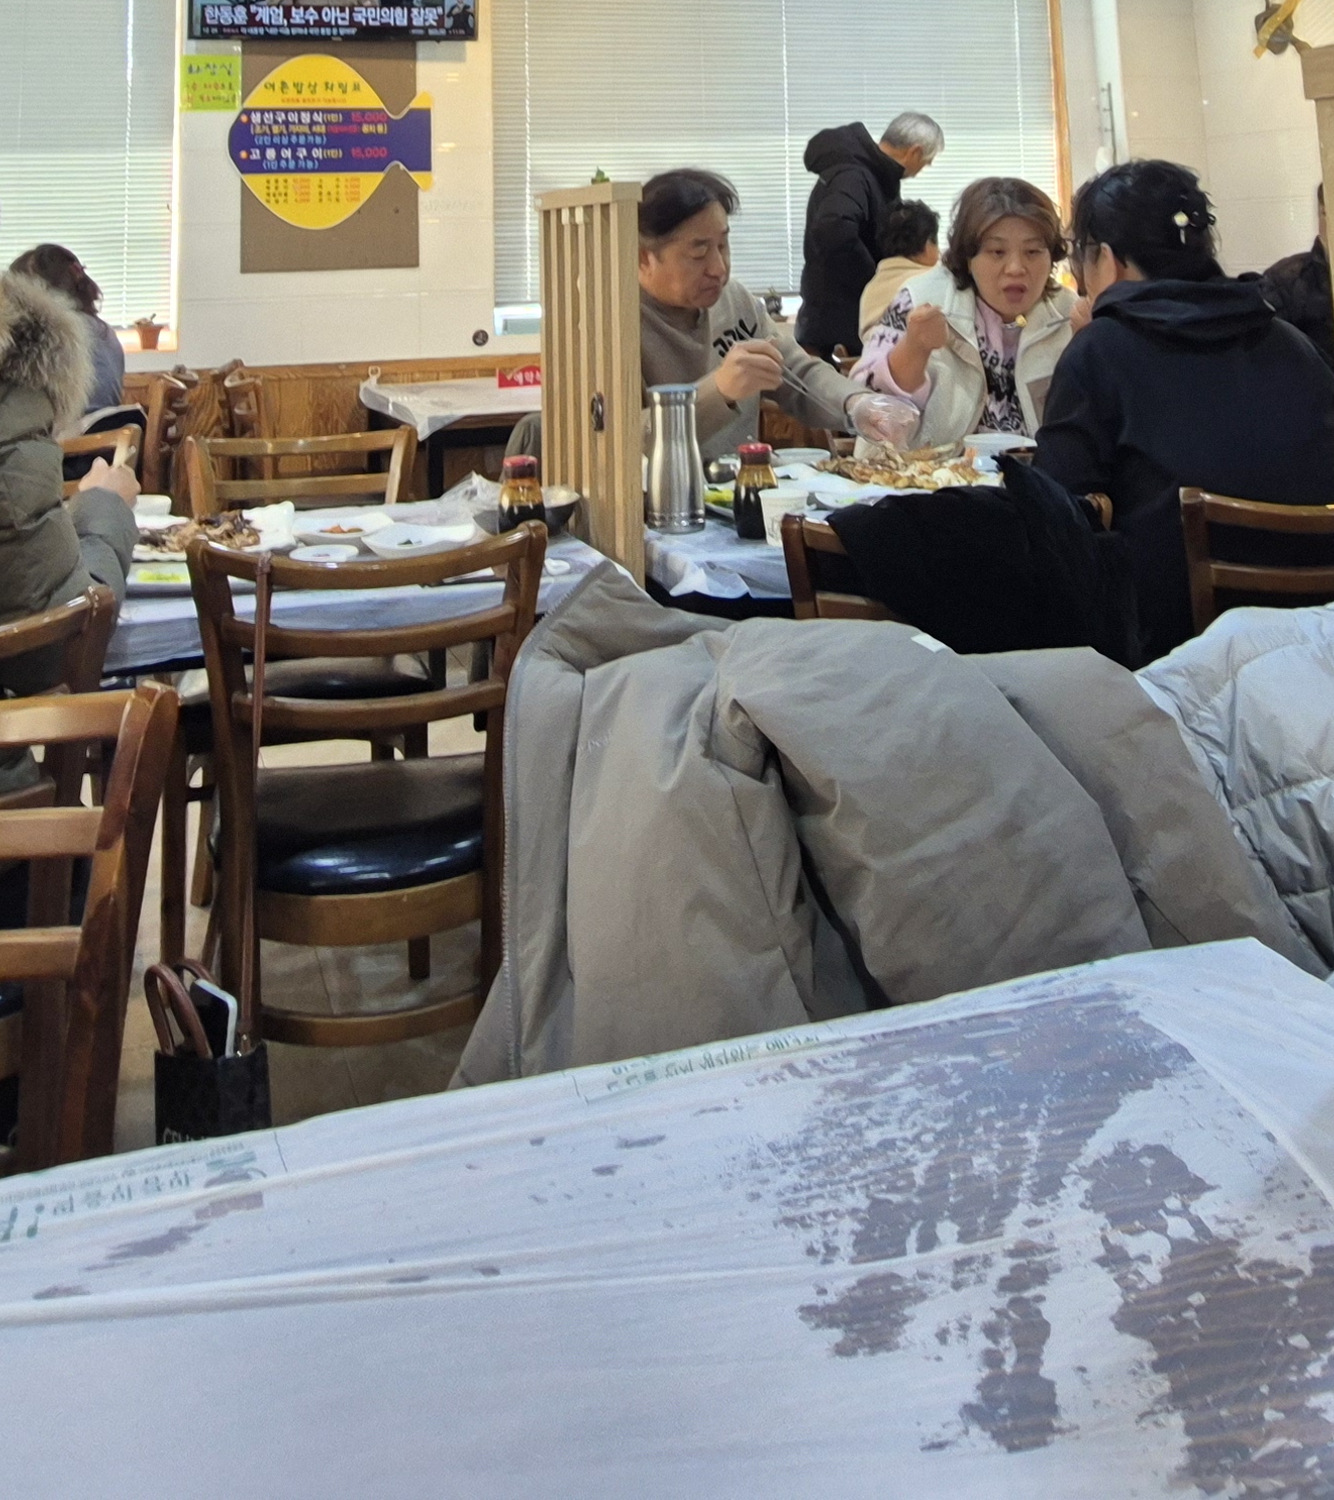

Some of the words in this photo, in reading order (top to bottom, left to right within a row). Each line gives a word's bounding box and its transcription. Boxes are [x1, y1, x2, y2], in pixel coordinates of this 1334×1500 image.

[205, 4, 247, 25] 한동훈
[290, 6, 319, 25] 보수
[321, 6, 350, 26] 아닌
[352, 6, 408, 27] 국민의힘
